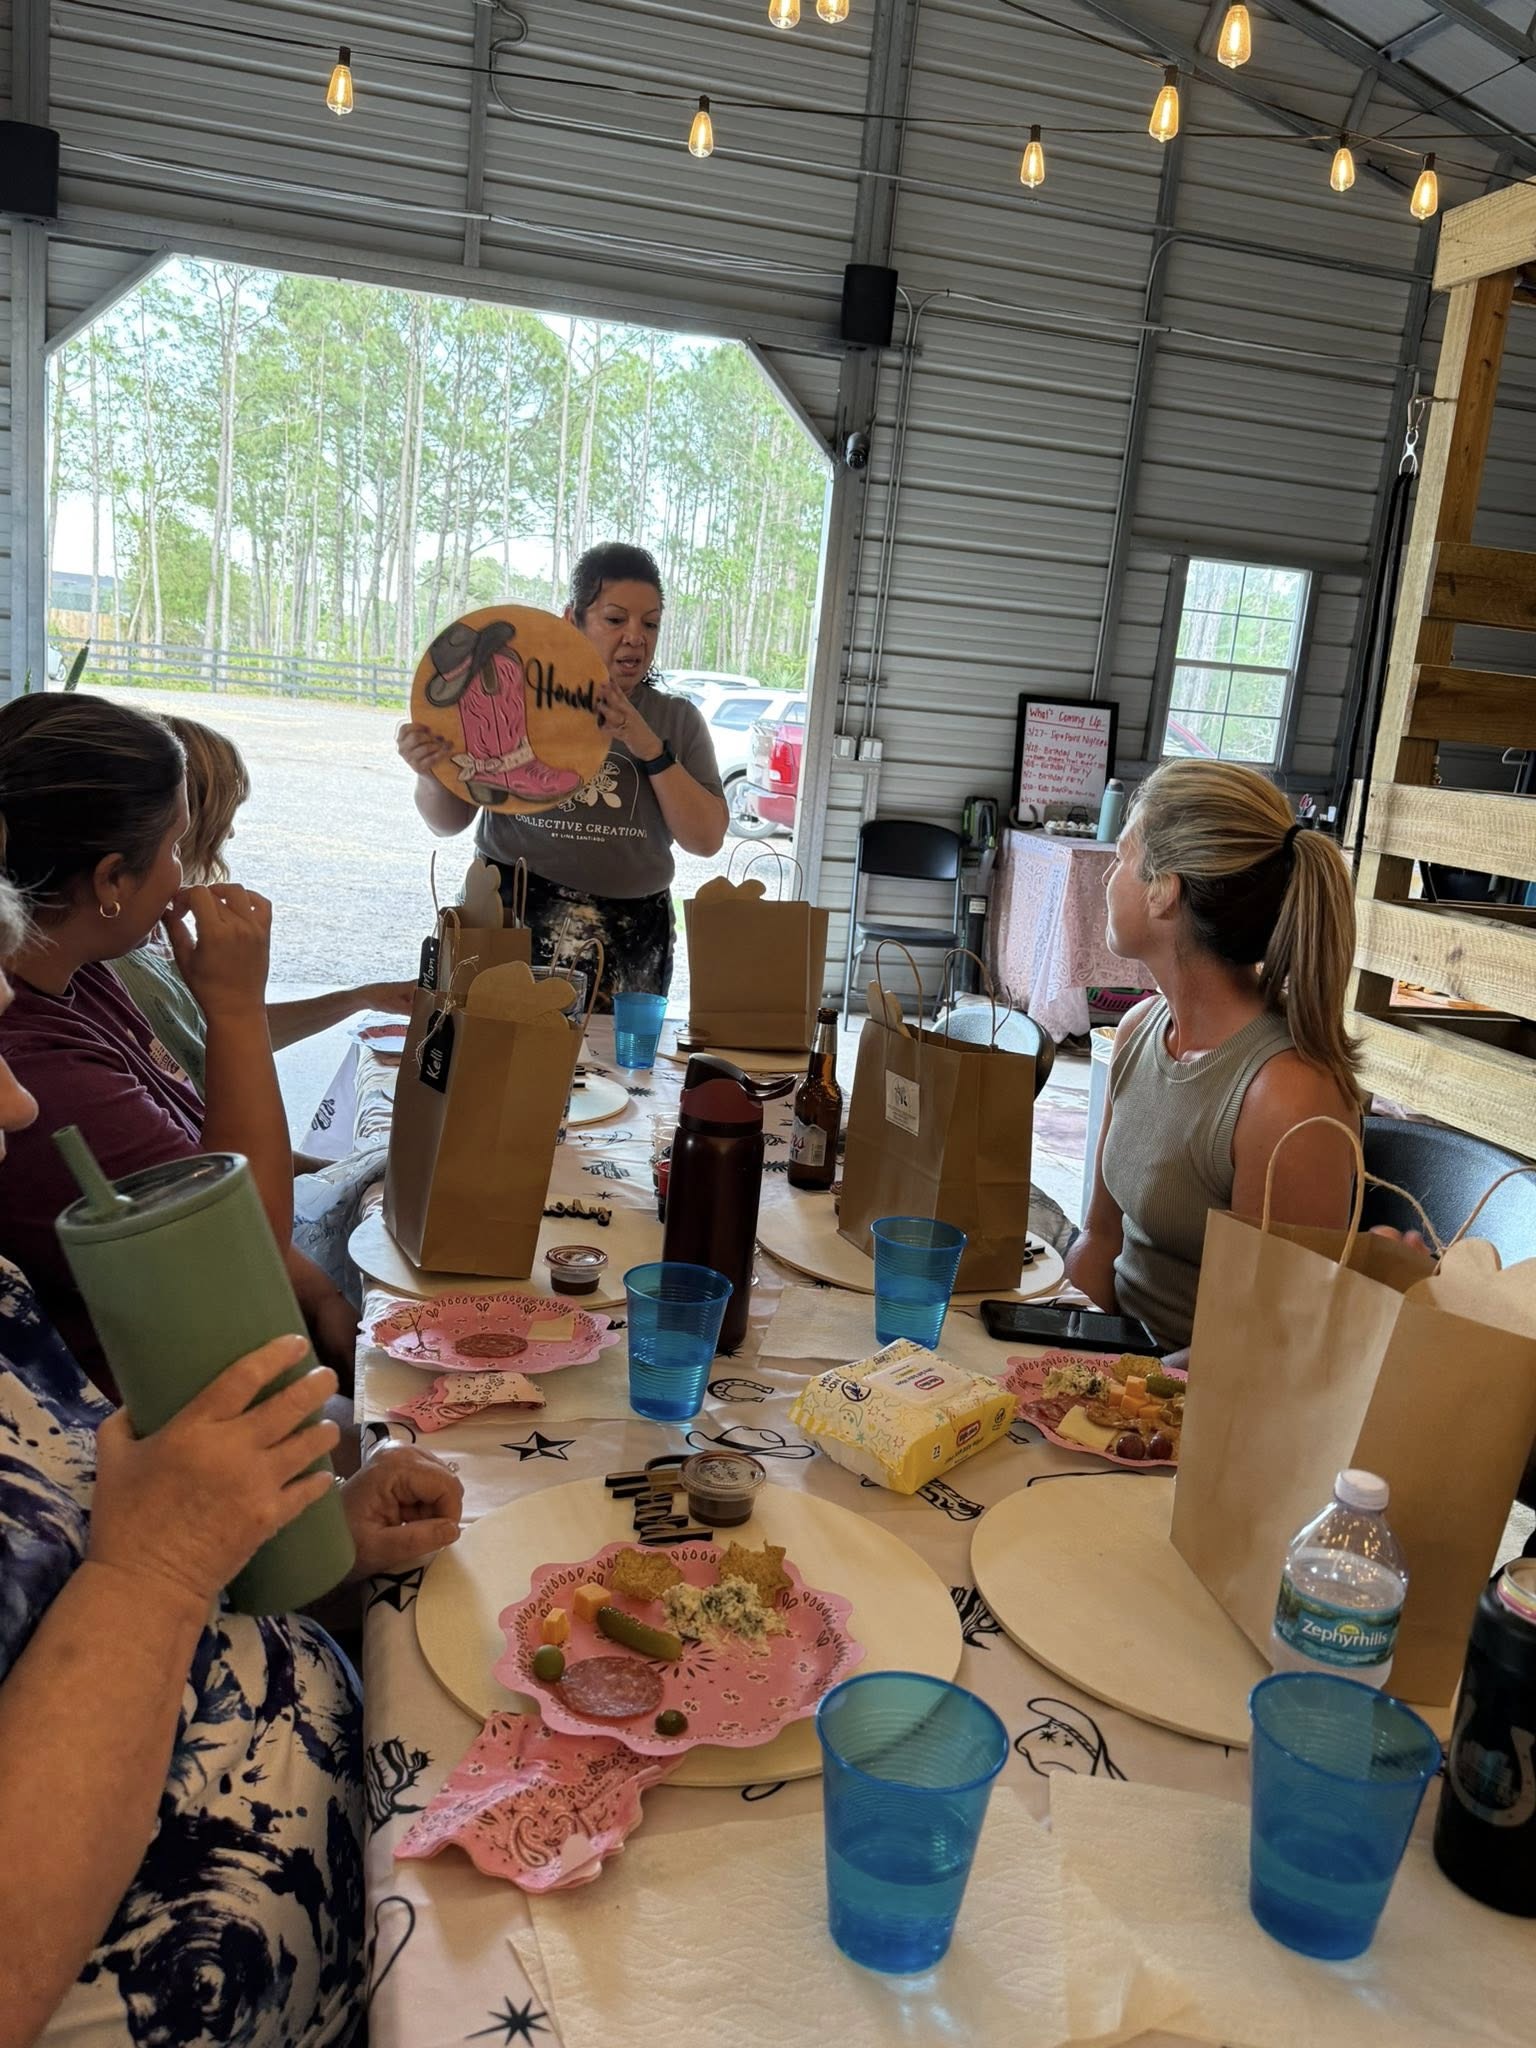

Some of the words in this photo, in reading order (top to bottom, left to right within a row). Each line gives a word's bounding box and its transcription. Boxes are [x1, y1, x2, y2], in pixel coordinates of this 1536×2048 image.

[515, 813, 583, 832] COLLECTIVE
[423, 957, 436, 990] Mom
[426, 1047, 444, 1080] Kelli
[1301, 1618, 1388, 1649] Zephyrhills
